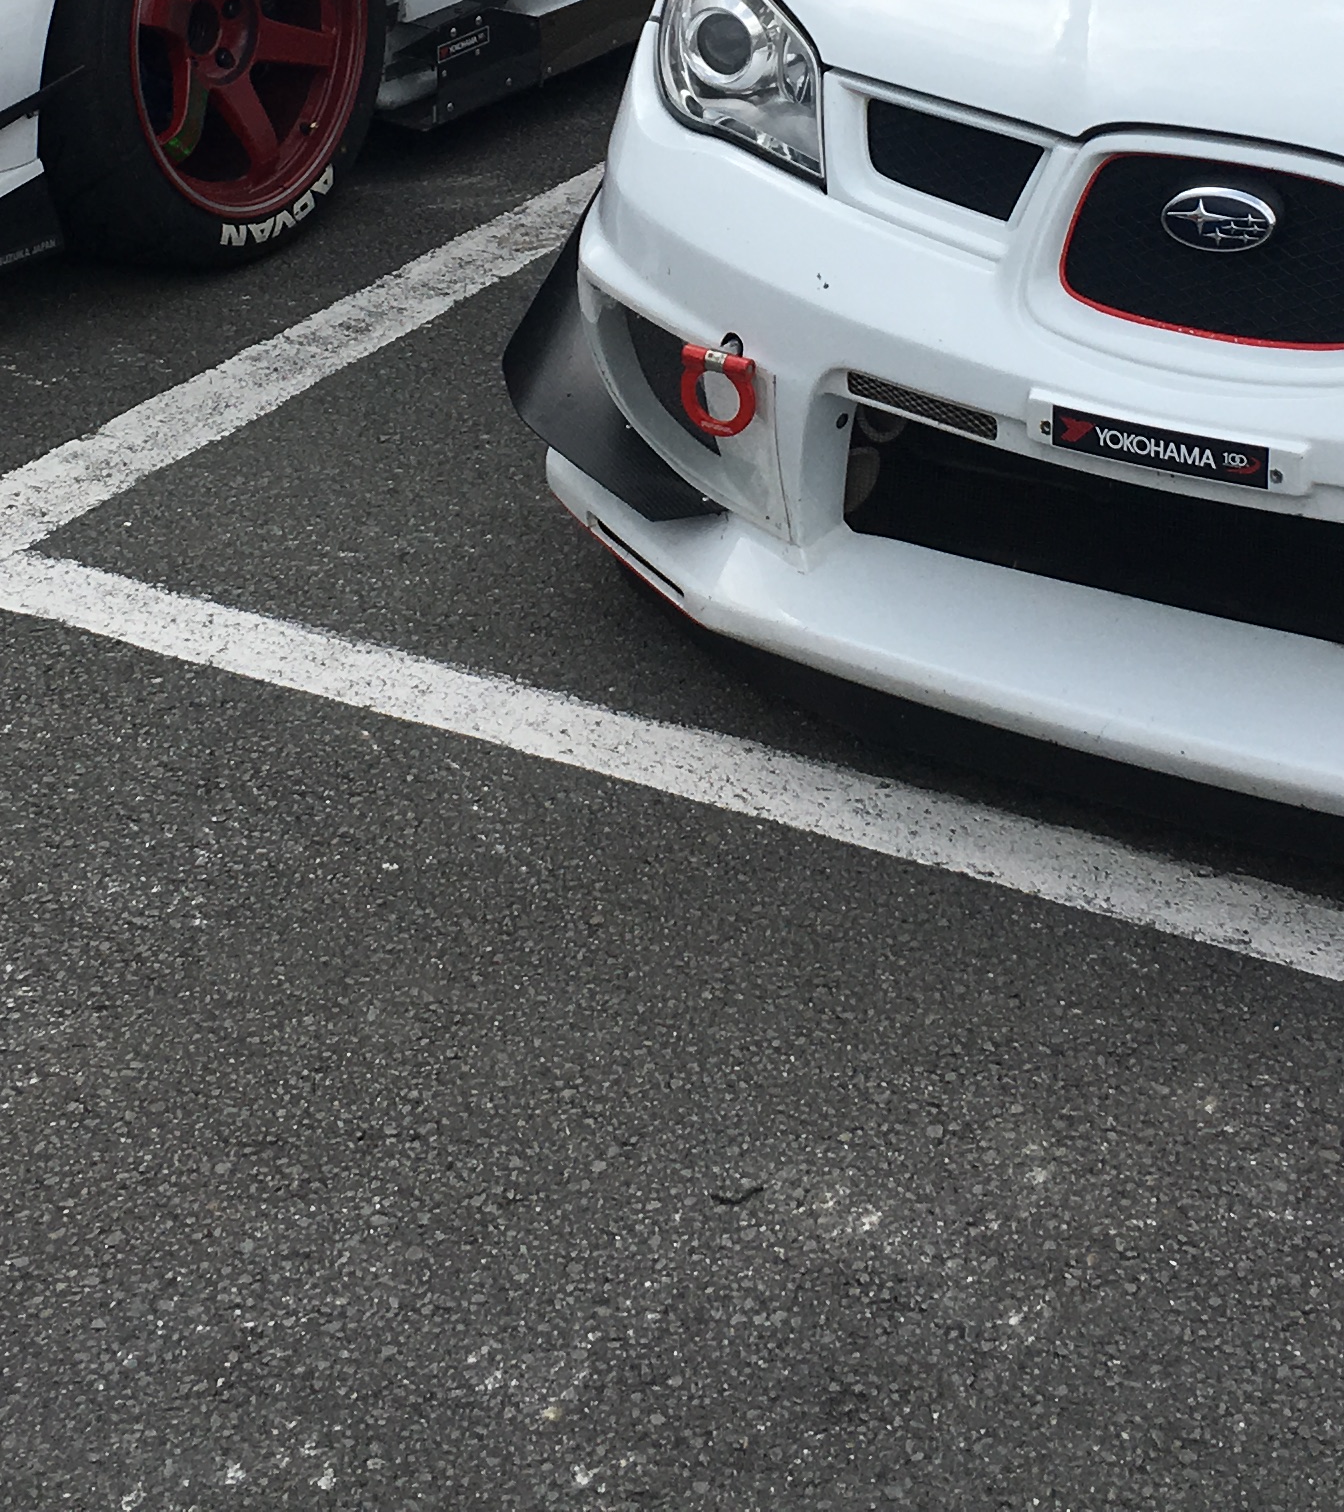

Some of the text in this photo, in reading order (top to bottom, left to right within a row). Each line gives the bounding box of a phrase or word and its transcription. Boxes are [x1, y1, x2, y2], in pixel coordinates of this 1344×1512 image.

[220, 163, 335, 246] ADVAN
[32, 238, 56, 254] JAPAN
[1095, 426, 1217, 470] YOKOHAMA
